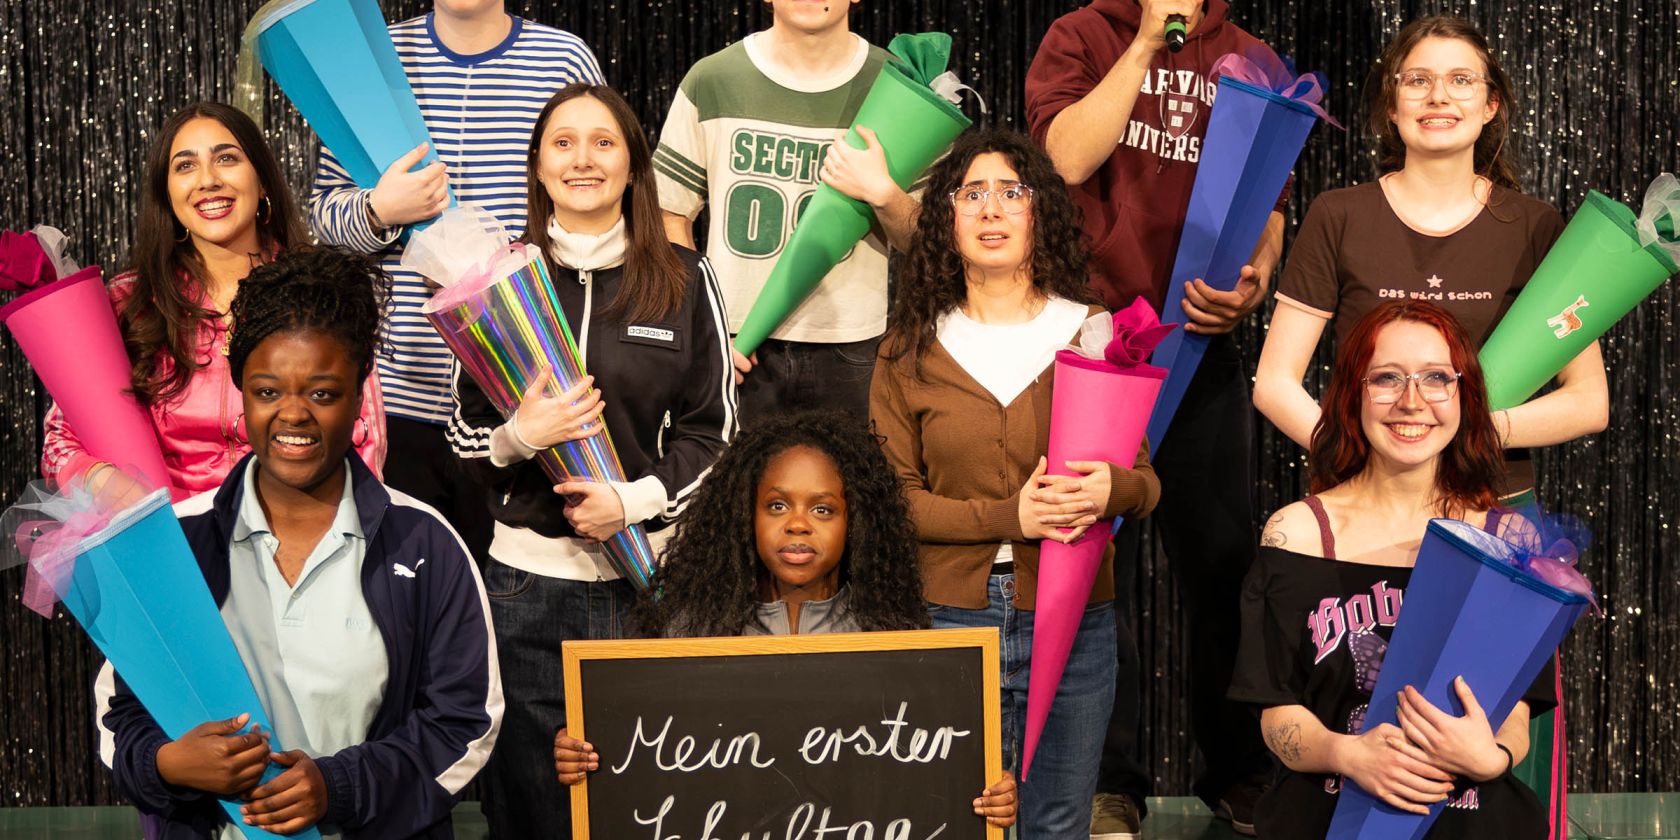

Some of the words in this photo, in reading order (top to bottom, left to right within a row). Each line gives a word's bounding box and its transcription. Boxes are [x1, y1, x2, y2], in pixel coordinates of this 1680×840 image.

[1140, 68, 1218, 107] ARVAR
[1118, 119, 1200, 163] NIVERS
[1379, 288, 1406, 299] Das
[1409, 291, 1443, 300] wird
[629, 328, 660, 337] adidas
[1307, 580, 1403, 665] Bab
[611, 715, 775, 774] Mein
[798, 701, 970, 763] erster
